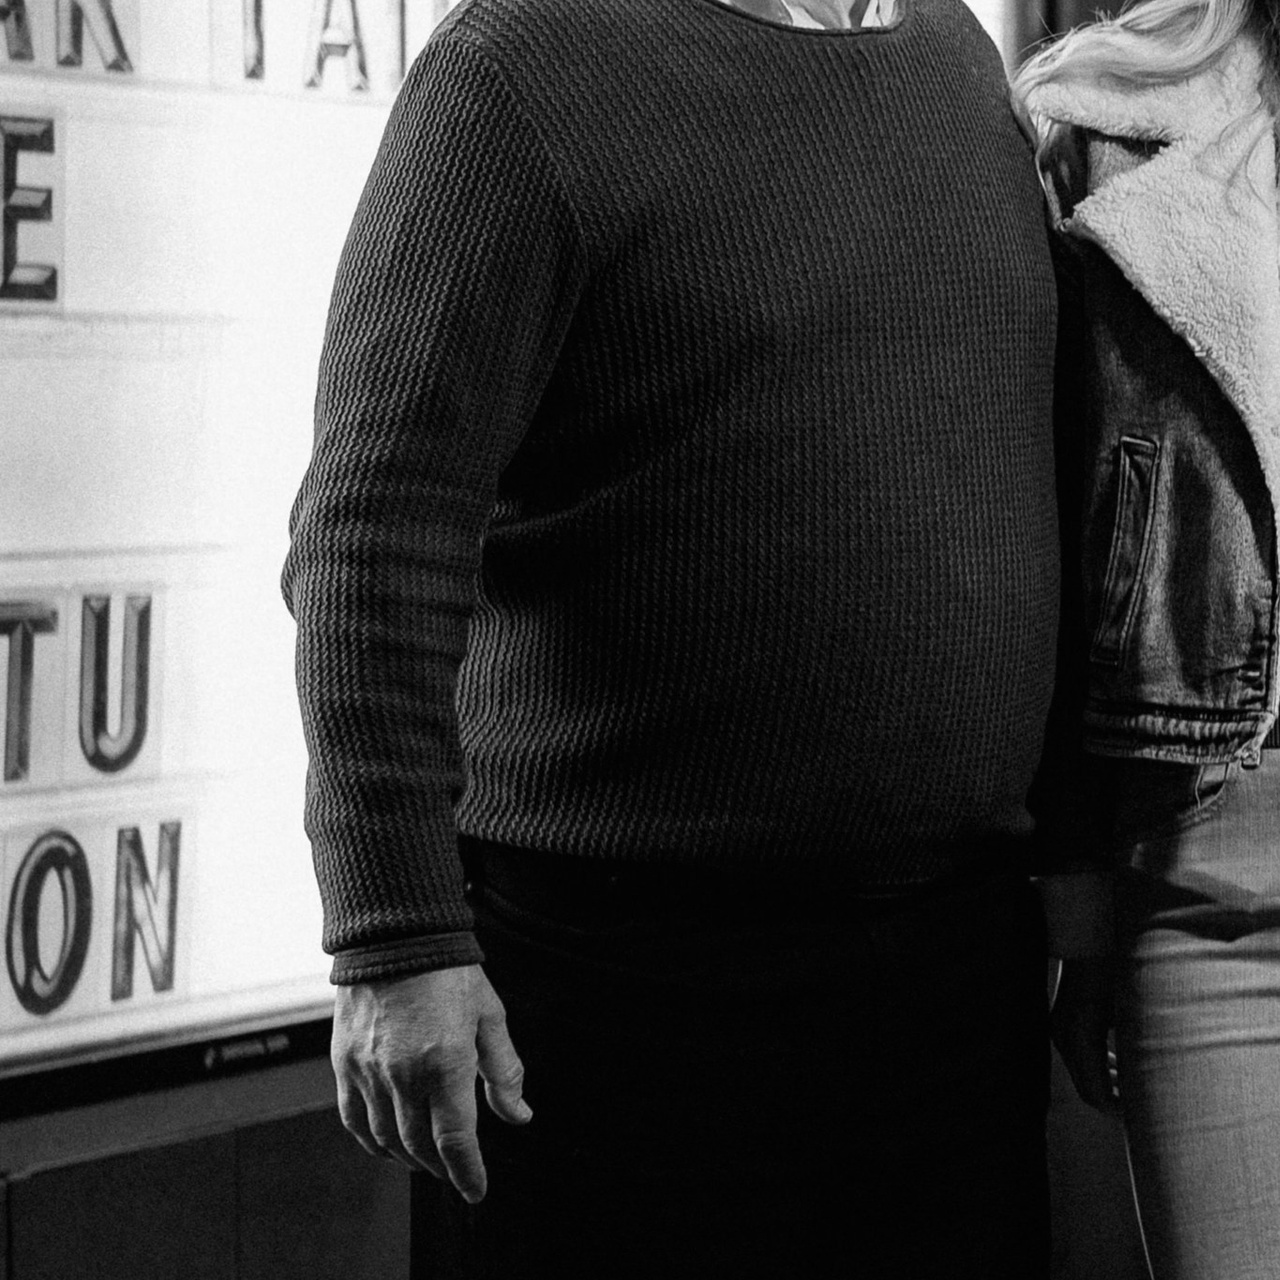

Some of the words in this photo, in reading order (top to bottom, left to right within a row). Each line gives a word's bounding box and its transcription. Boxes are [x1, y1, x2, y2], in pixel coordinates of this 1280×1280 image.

[0, 114, 58, 302] E
[0, 593, 152, 782] TU
[5, 822, 182, 1016] ON
